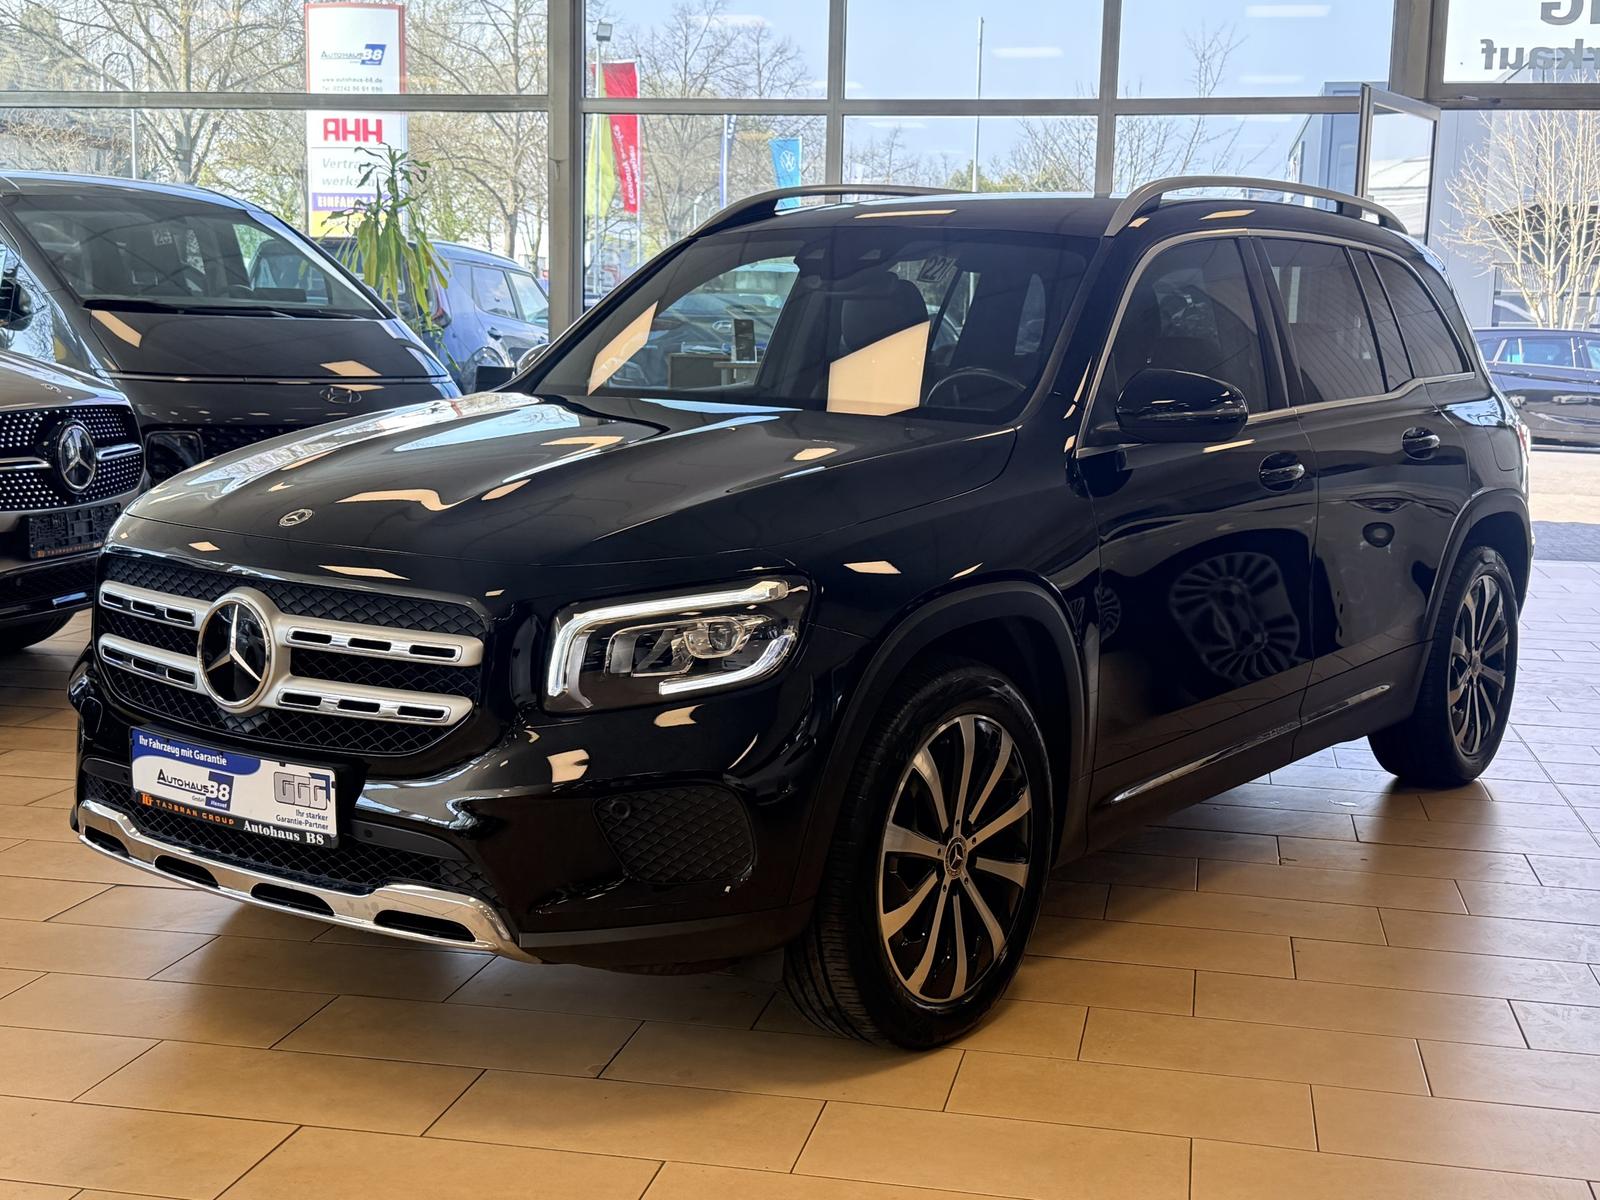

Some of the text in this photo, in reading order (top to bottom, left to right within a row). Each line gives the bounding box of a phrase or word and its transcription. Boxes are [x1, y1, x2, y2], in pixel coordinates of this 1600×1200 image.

[139, 735, 227, 766] Ihr Fahrzeug mit Garantie
[275, 814, 328, 830] Garantie-Partner
[295, 809, 328, 821] Ihr starker
[243, 820, 325, 846] Autohaus B8
